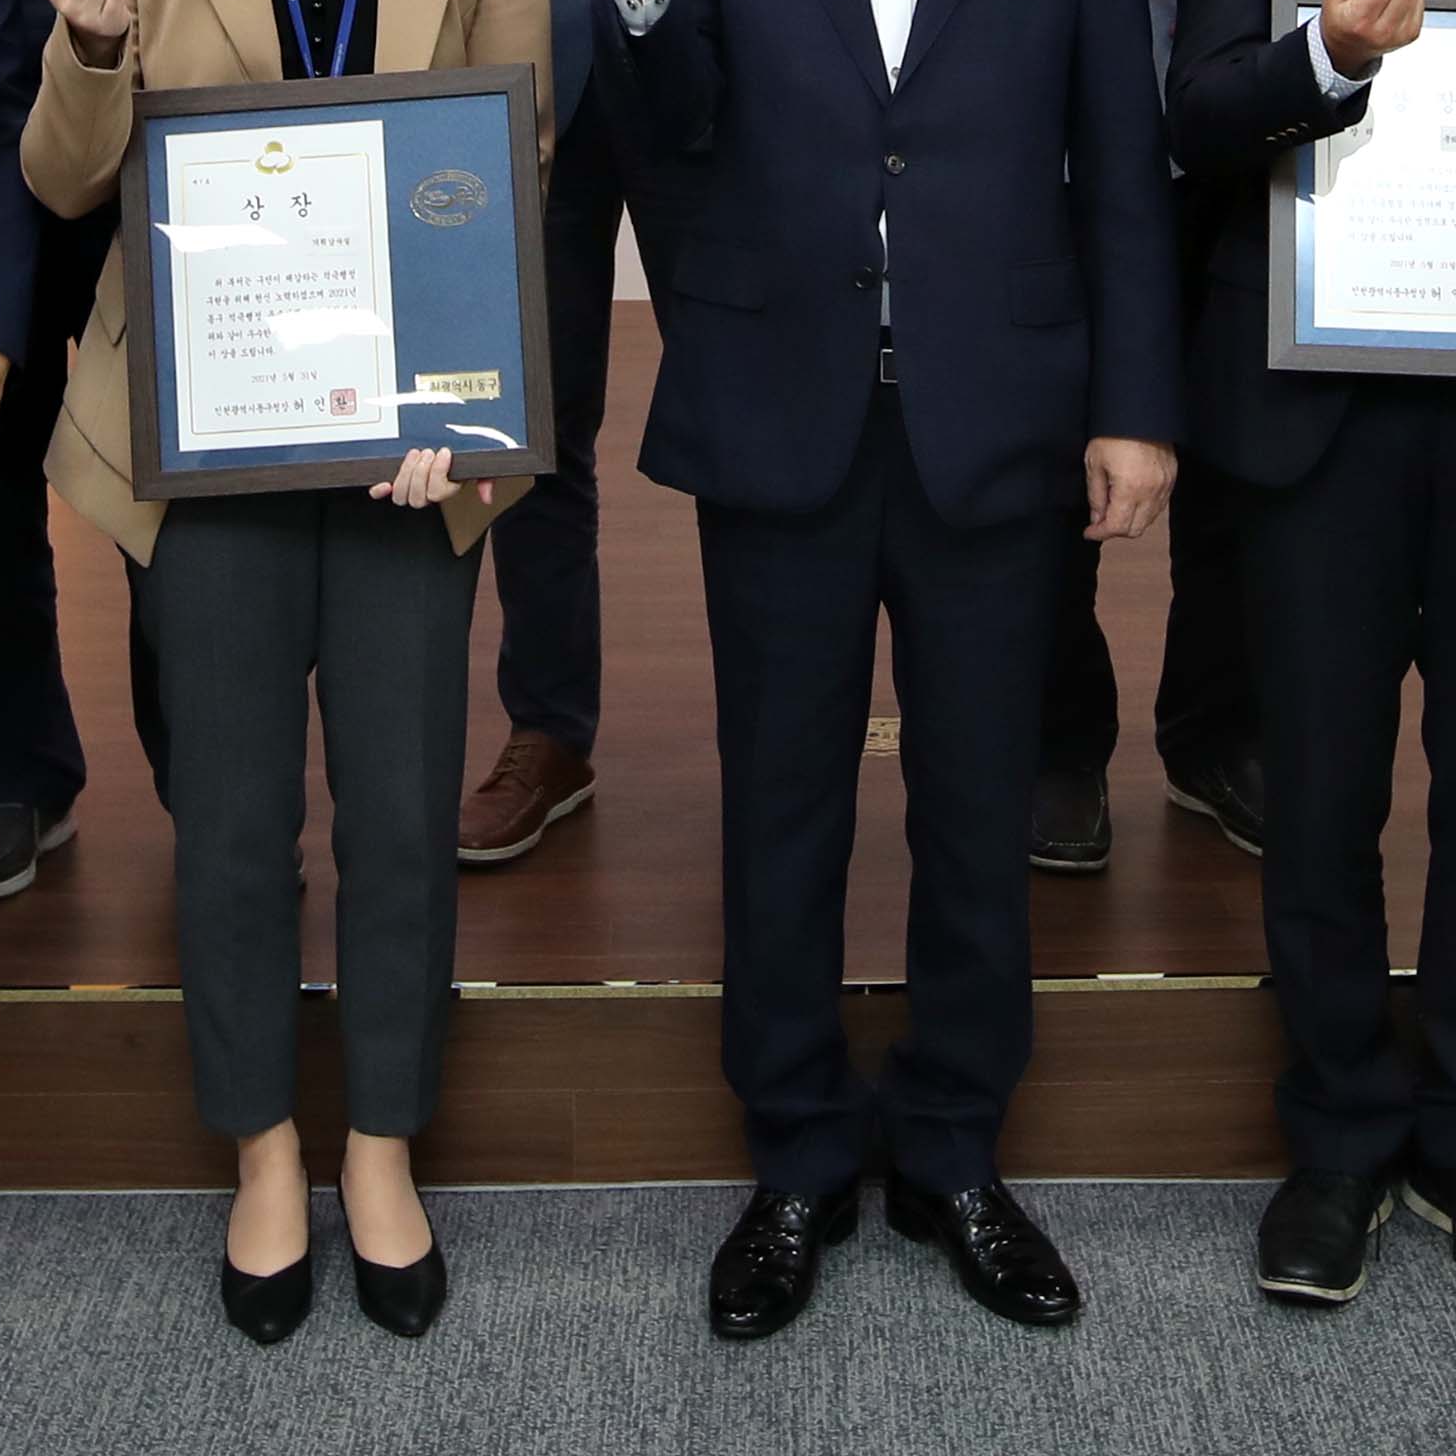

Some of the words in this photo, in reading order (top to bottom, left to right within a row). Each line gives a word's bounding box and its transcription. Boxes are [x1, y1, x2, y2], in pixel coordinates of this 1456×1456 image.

[242, 194, 265, 222] 상
[290, 191, 312, 219] 장
[476, 378, 497, 392] 동구
